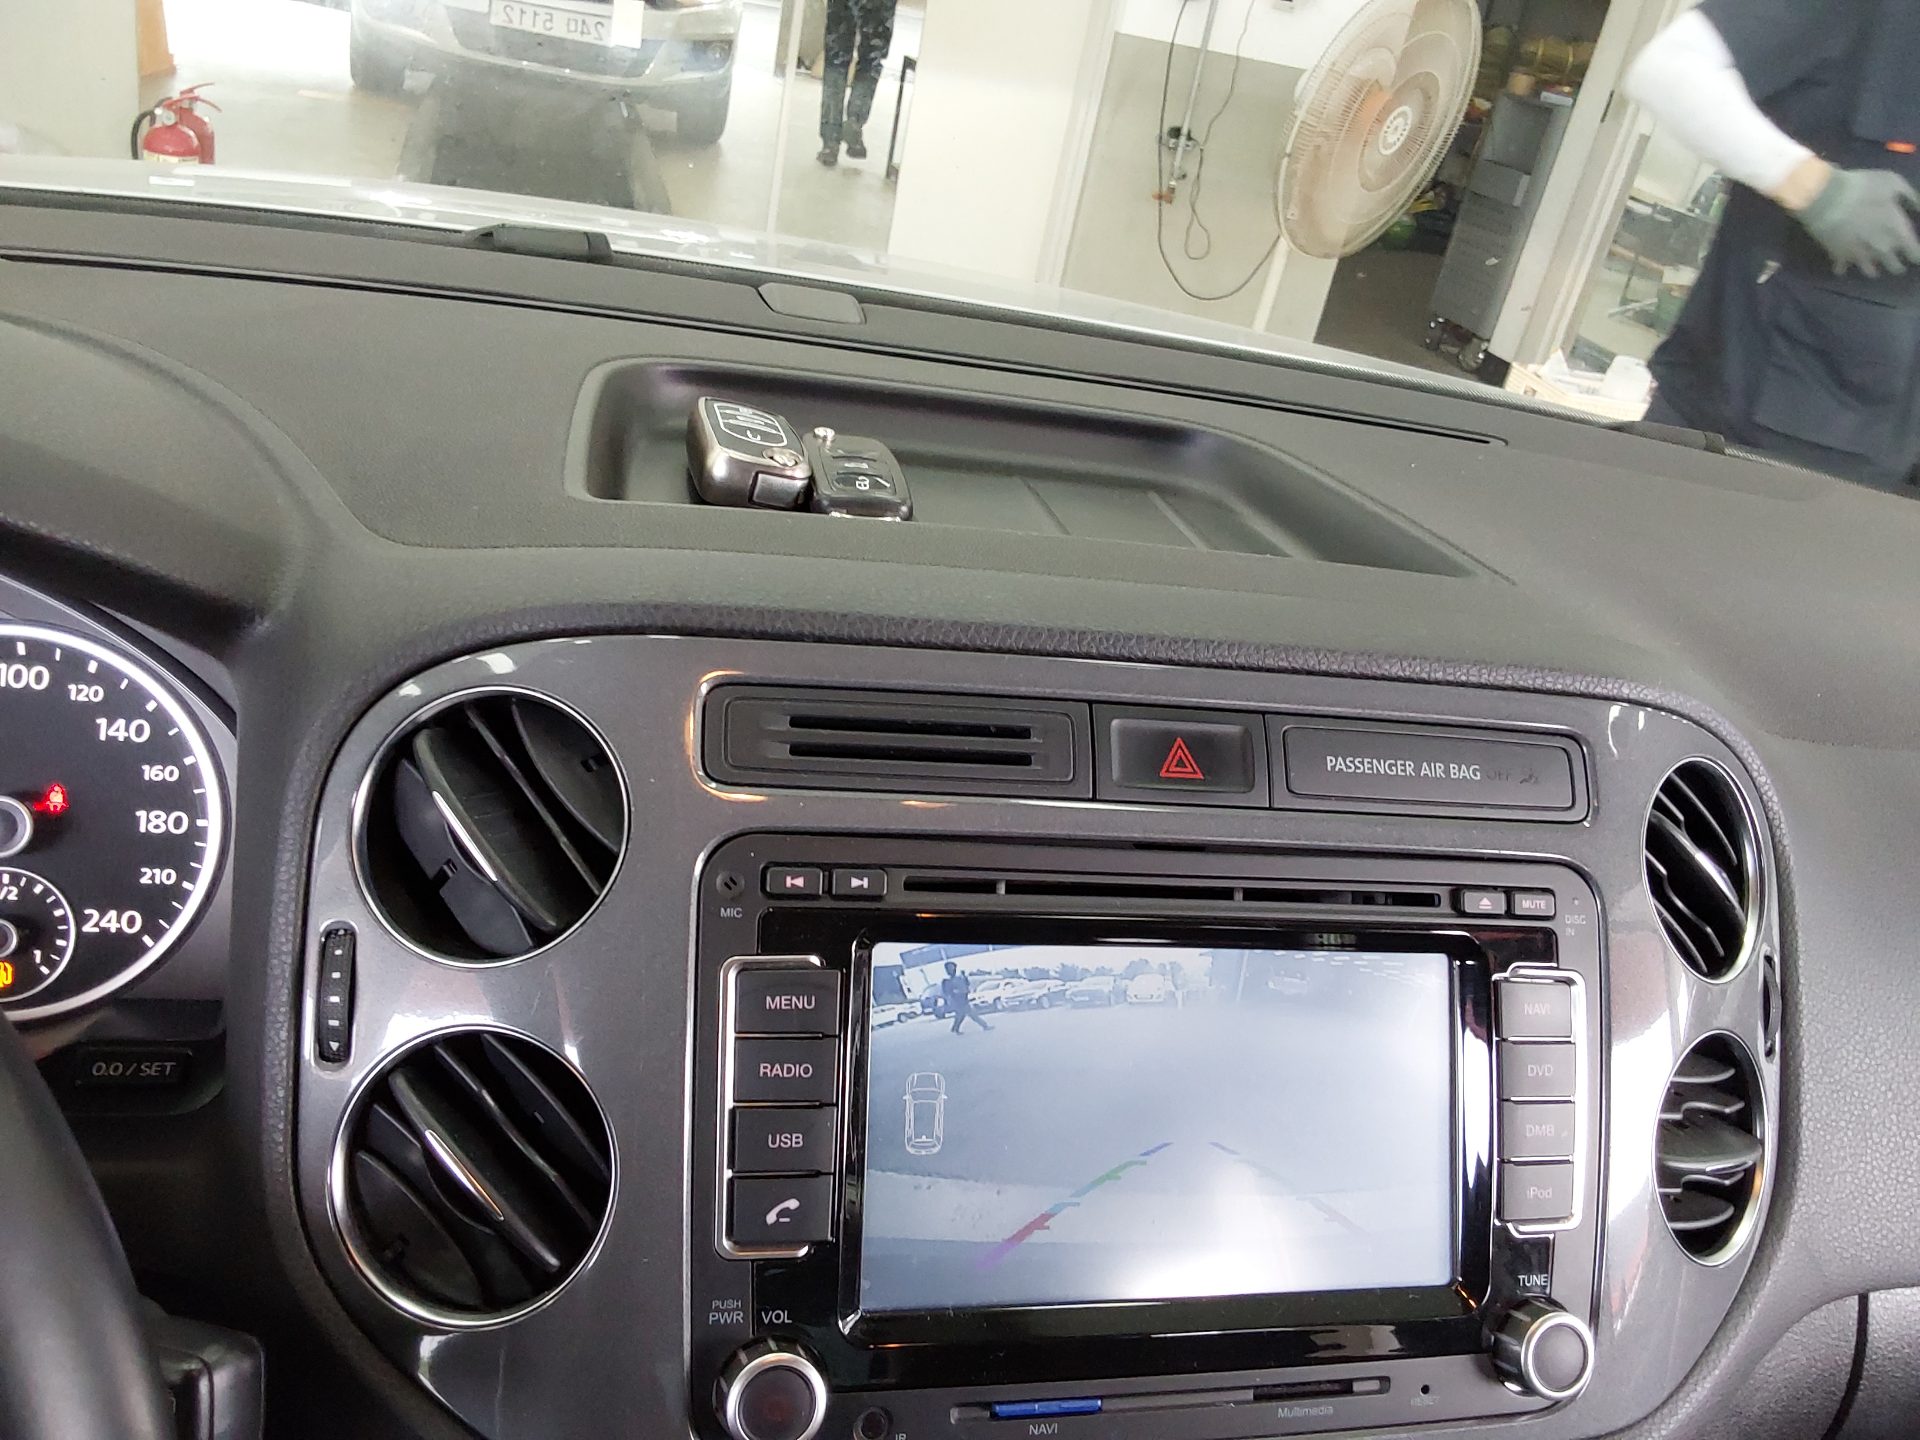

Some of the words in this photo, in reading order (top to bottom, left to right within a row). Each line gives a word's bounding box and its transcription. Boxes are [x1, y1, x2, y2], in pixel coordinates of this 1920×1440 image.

[0, 662, 50, 691] 100
[67, 683, 104, 703] 120
[96, 718, 150, 743] 140
[142, 765, 179, 782] 160
[1326, 755, 1416, 777] PASSENGER
[1420, 762, 1446, 779] AIR
[1450, 763, 1480, 780] BAG
[135, 810, 188, 834] 180
[139, 868, 176, 885] 210
[1522, 899, 1546, 910] MUTE
[720, 907, 742, 918] MIC
[1565, 914, 1586, 925] DISC
[82, 909, 142, 934] 240
[1566, 927, 1575, 936] IN
[33, 949, 42, 964] 1
[765, 995, 816, 1010] MENU
[759, 1063, 813, 1078] RADIO
[1527, 1064, 1553, 1077] DVD
[1526, 1124, 1555, 1137] DMB
[768, 1133, 804, 1148] USB
[1527, 1187, 1552, 1199] iPod
[1517, 1274, 1549, 1287] TUNE
[711, 1299, 742, 1309] PUSH
[708, 1311, 743, 1324] PWR
[761, 1310, 792, 1324] VOL
[1278, 1406, 1334, 1418] Multimedia
[1029, 1423, 1058, 1434] NAVI
